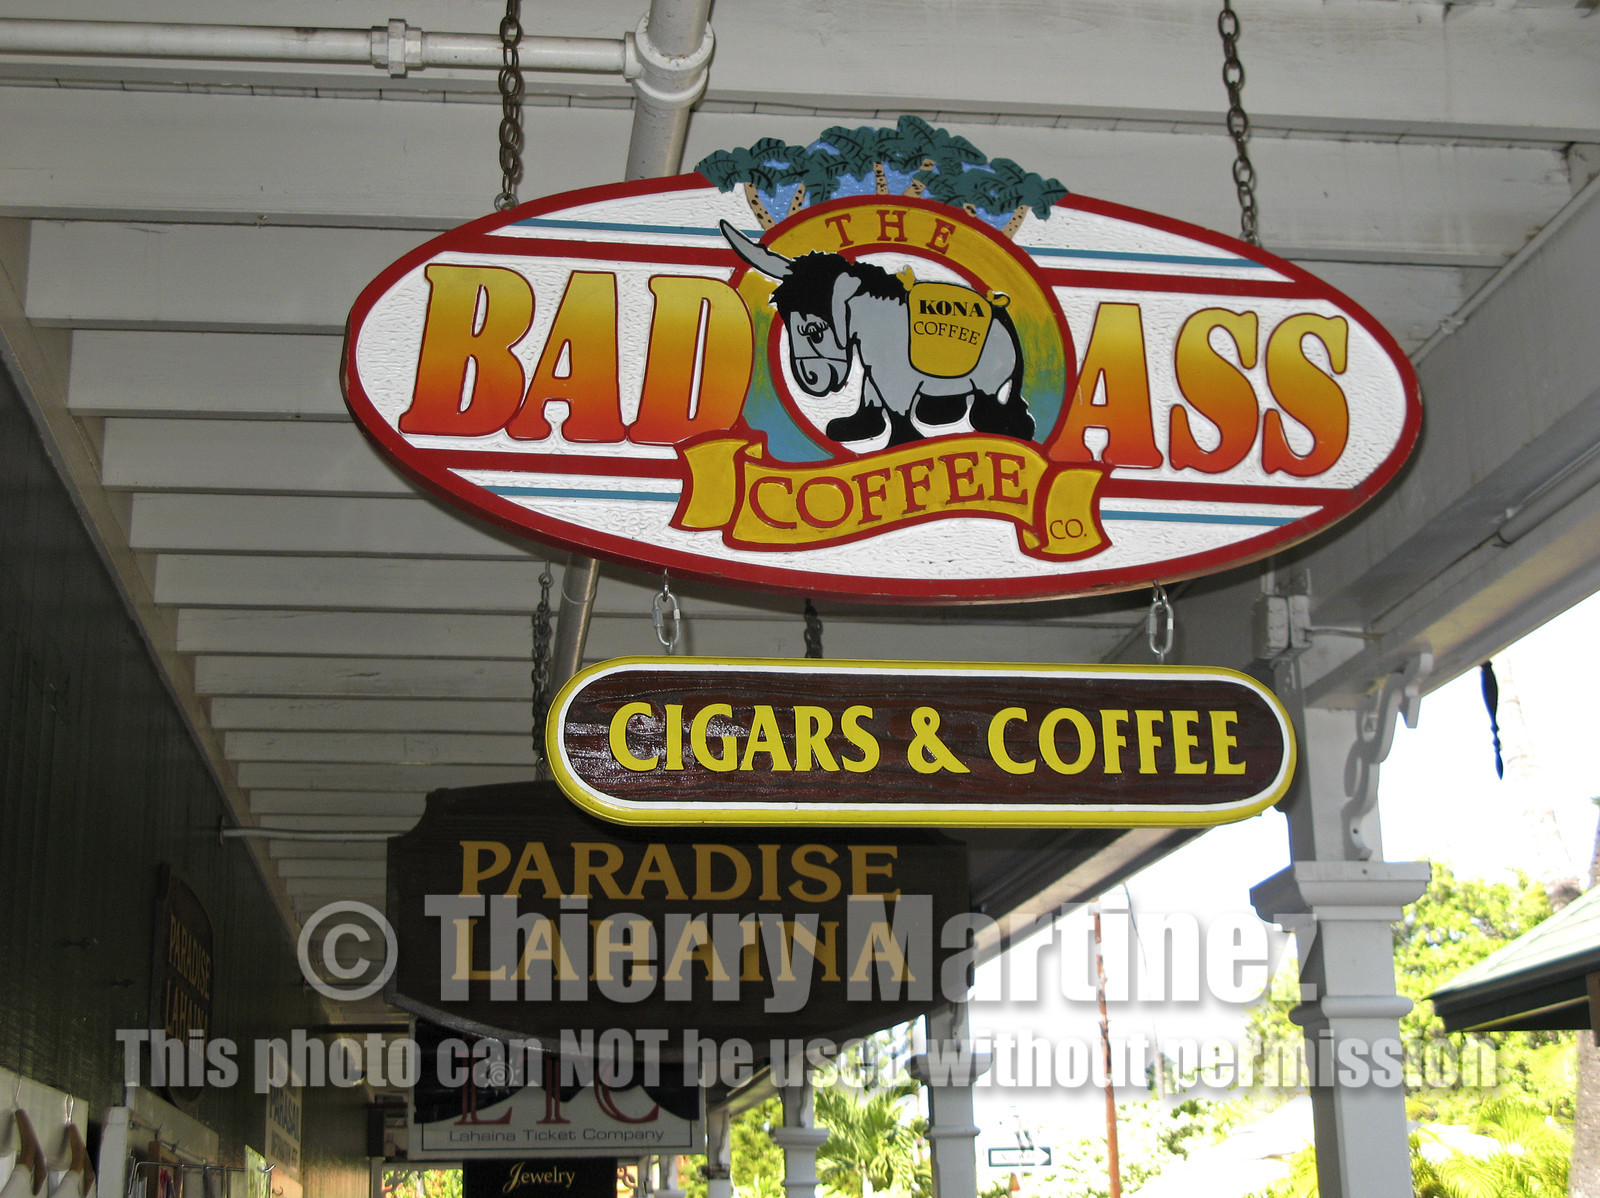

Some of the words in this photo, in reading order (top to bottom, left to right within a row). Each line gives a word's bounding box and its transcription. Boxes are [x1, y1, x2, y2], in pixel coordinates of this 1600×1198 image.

[824, 208, 957, 256] THE
[913, 320, 982, 347] COFFEE
[918, 298, 986, 319] KONA
[398, 262, 756, 448] BAD
[1047, 300, 1350, 478] ASS
[748, 450, 1030, 530] COFFEE
[1049, 518, 1088, 541] CO.
[608, 701, 882, 774] CIGARS
[906, 705, 972, 775] &
[987, 706, 1248, 777] COFFEE
[457, 840, 902, 902] PARADISE
[168, 912, 212, 1000] PARADISE
[450, 918, 917, 983] LAHAINA
[450, 1127, 517, 1142] Lahaina
[522, 1127, 577, 1142] Ticket
[582, 1127, 665, 1143] Company
[503, 1161, 577, 1194] Jewelry
